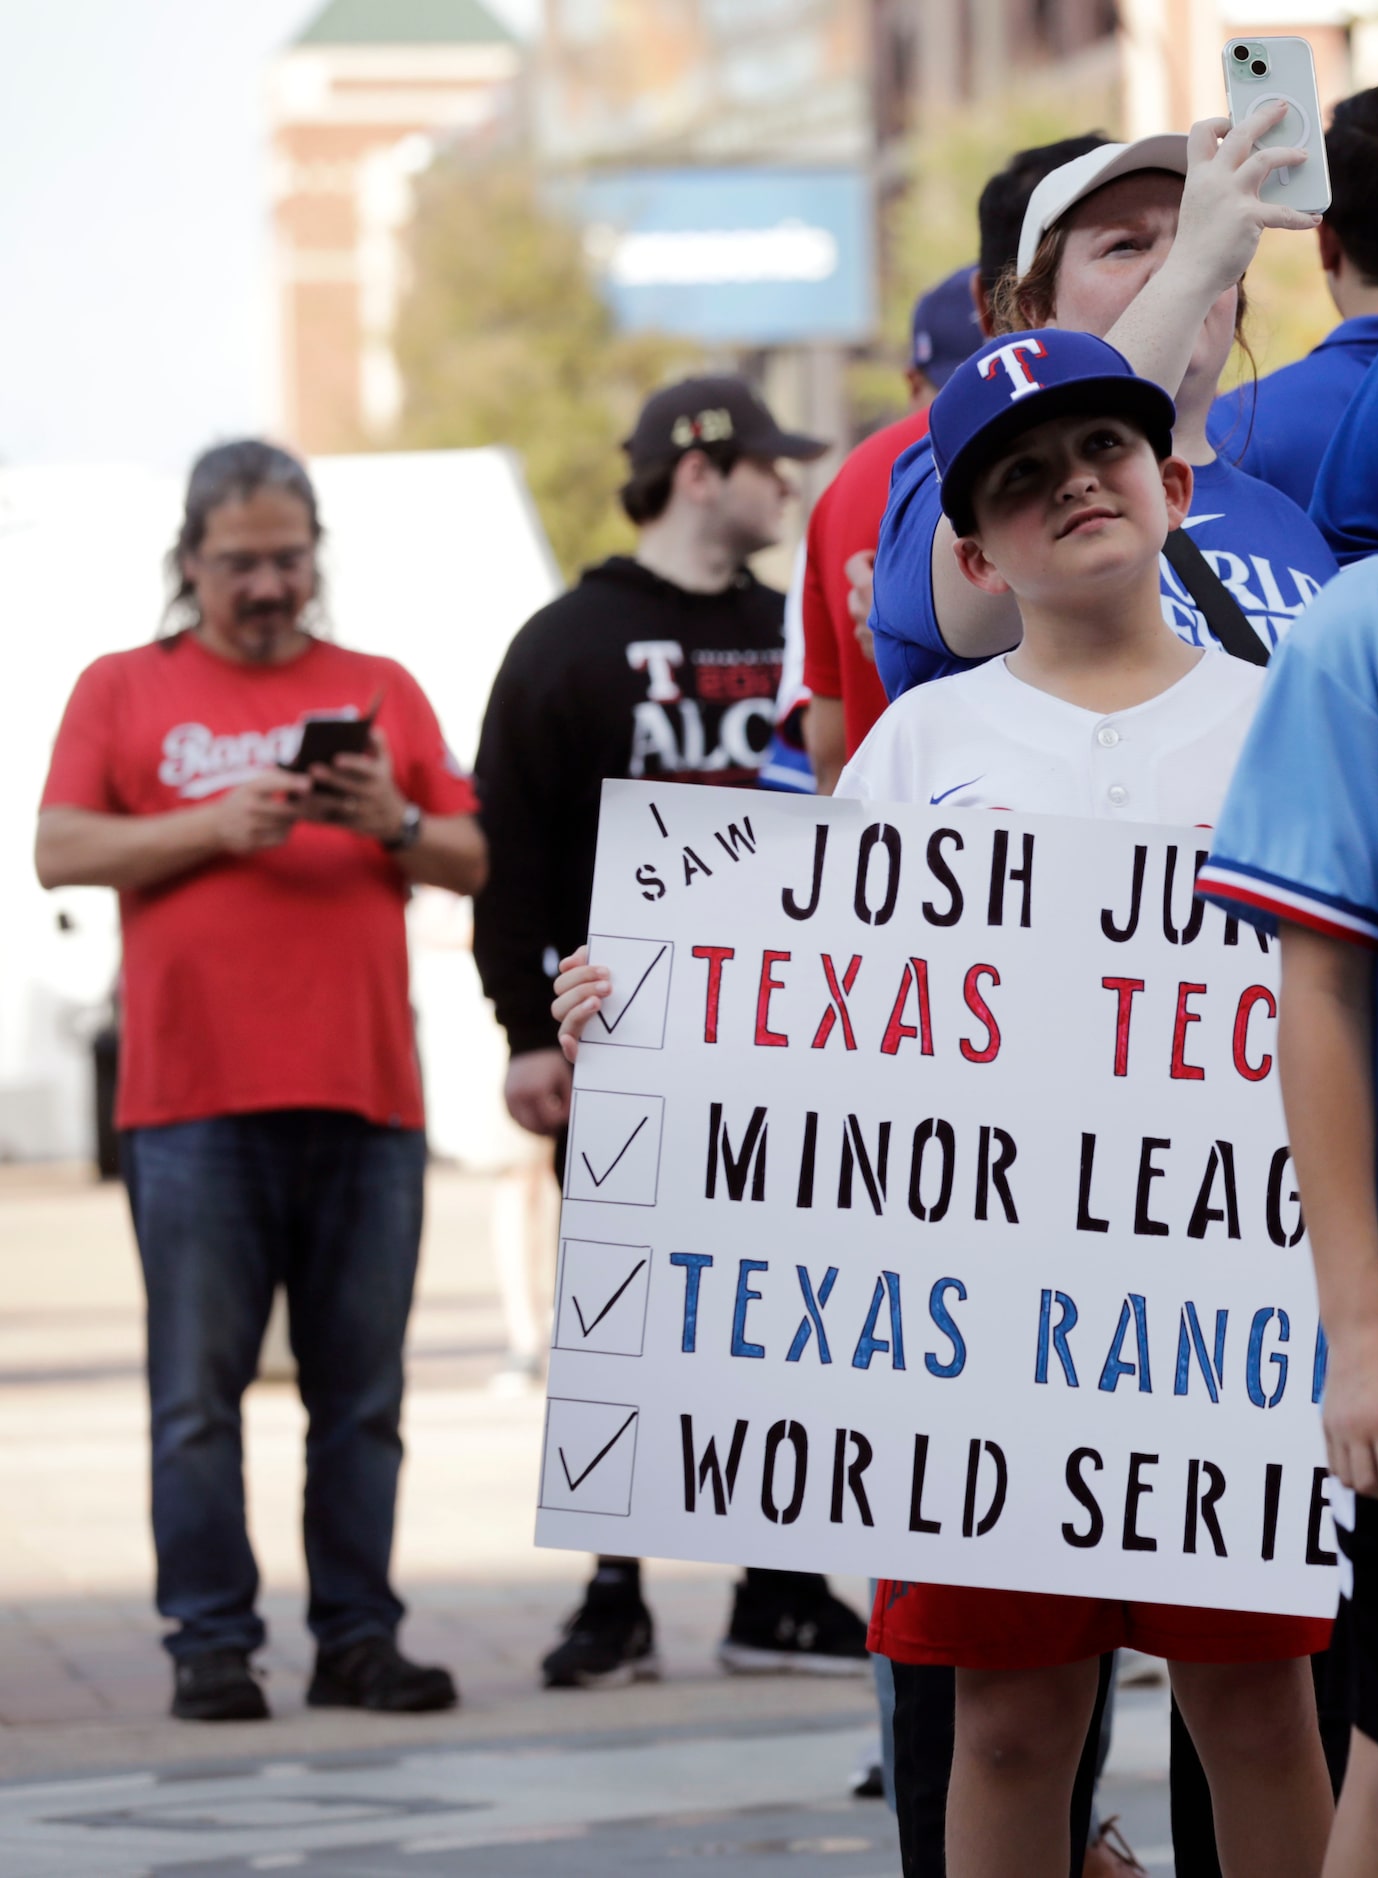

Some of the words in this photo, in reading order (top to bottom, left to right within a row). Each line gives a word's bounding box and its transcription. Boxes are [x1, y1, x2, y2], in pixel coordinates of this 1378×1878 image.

[977, 338, 1048, 402] T
[625, 639, 684, 704] T
[636, 816, 756, 901] SAW
[649, 803, 668, 838] I
[782, 823, 1034, 927] JOSH
[692, 946, 1001, 1063] TEXAS
[1102, 976, 1277, 1081] TEC
[706, 1103, 1019, 1223] MINOR
[670, 1253, 967, 1378] TEXAS
[681, 1414, 1007, 1537] WORLD
[1062, 1447, 1338, 1566] SERIE
